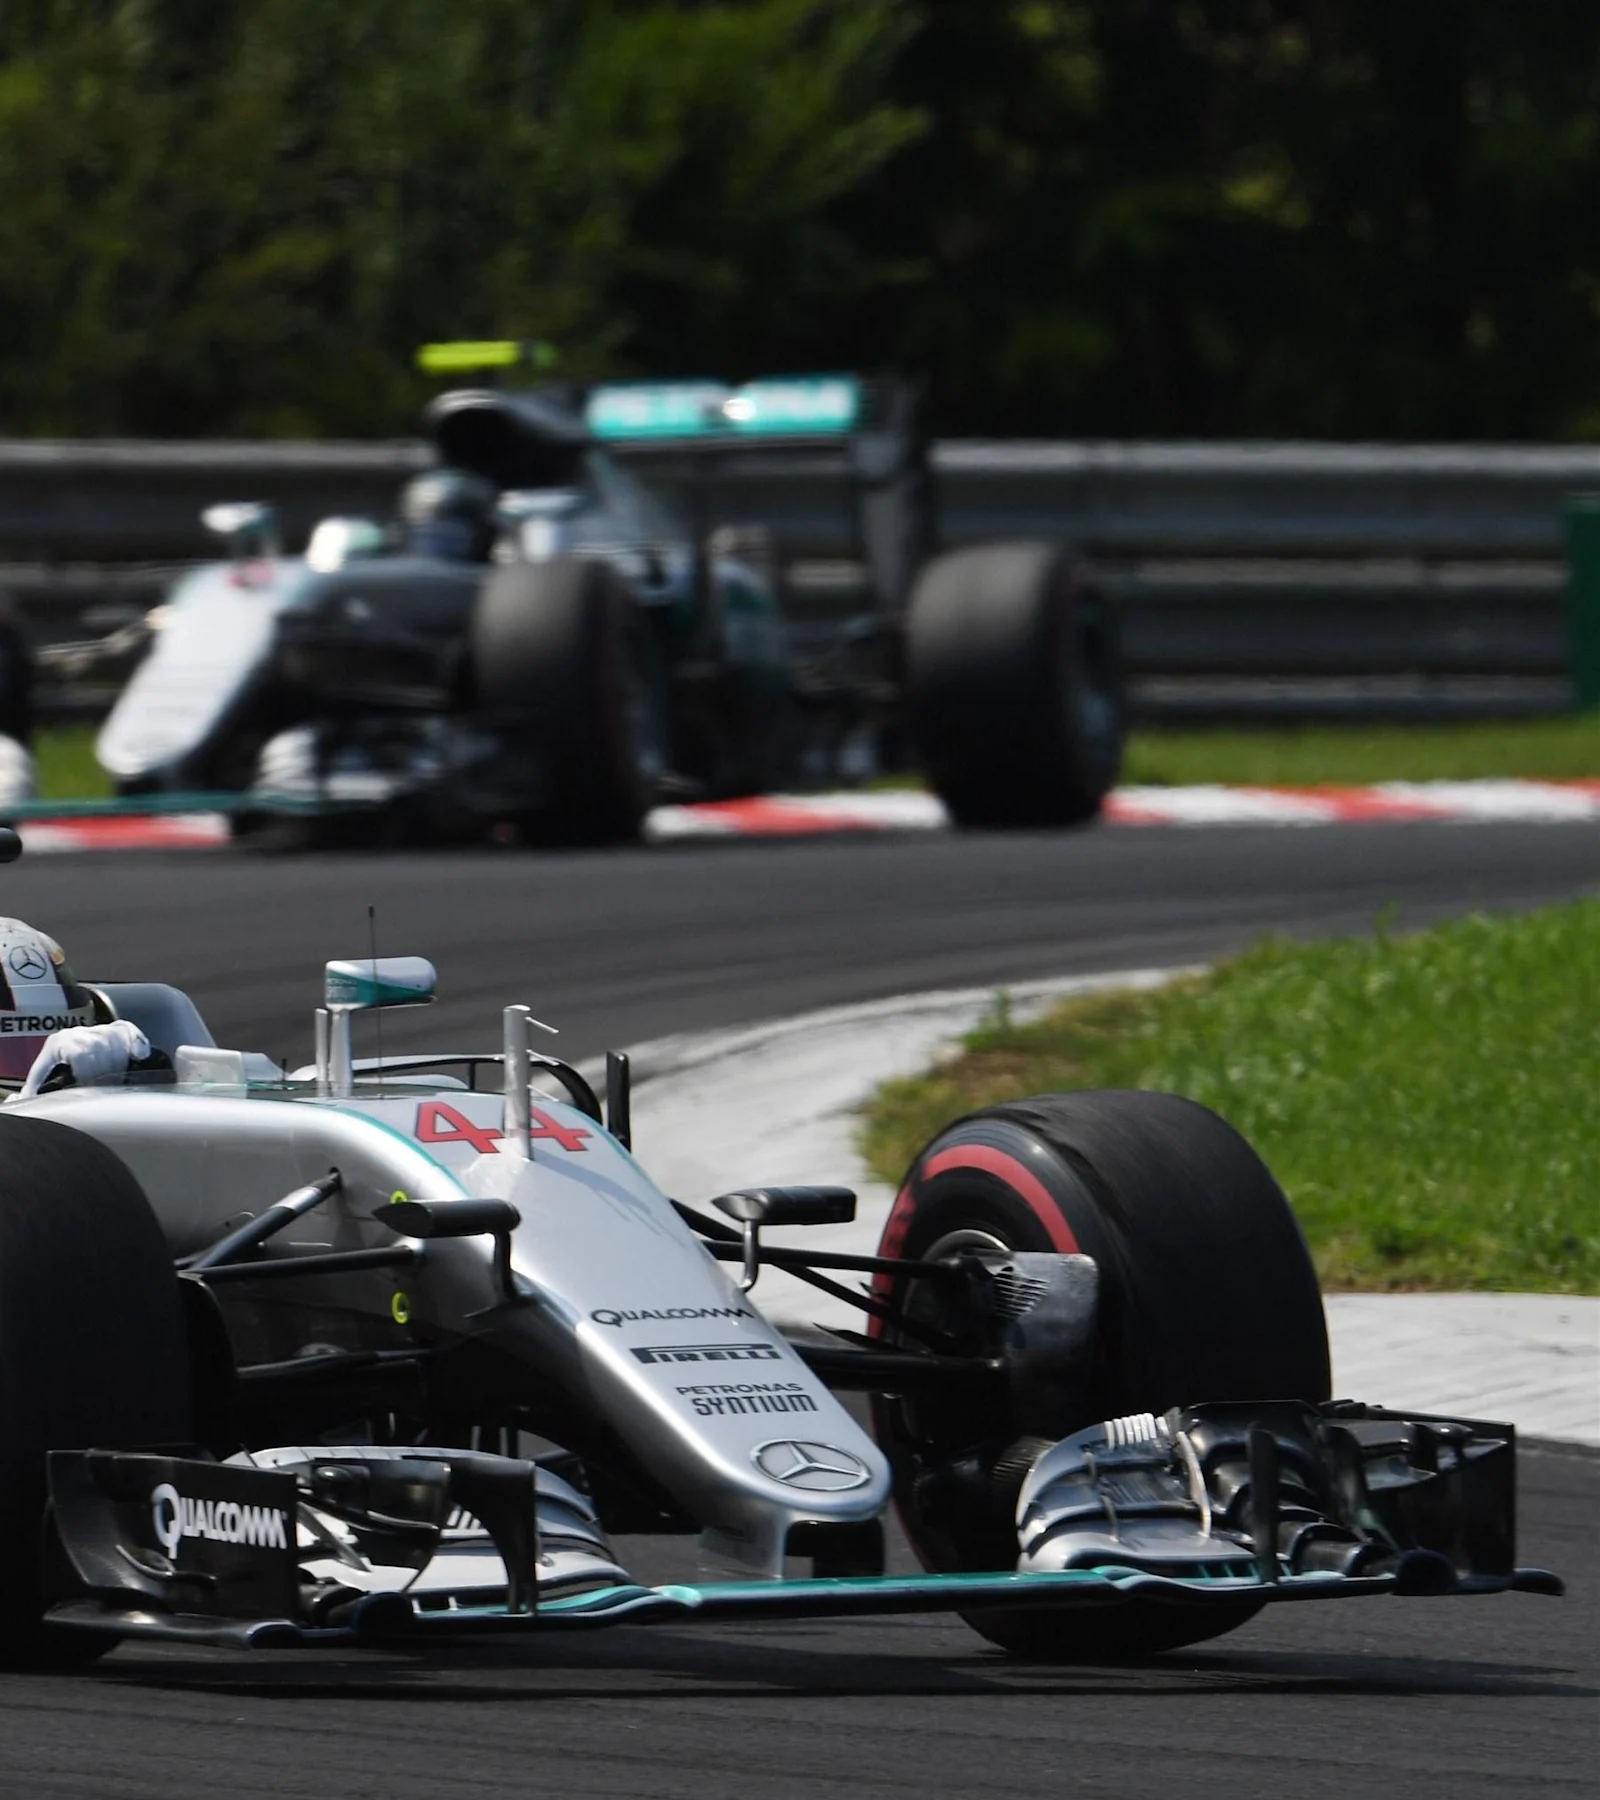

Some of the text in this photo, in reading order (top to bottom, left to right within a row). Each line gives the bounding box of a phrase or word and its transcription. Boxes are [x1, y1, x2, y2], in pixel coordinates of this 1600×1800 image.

[415, 1101, 593, 1154] 44
[590, 1307, 755, 1328] QUALCOMM
[630, 1343, 783, 1364] PIRELLI
[675, 1382, 804, 1397] PETRONAS
[692, 1394, 818, 1415] SYNTIUM
[152, 1483, 287, 1559] QUALCOMM
